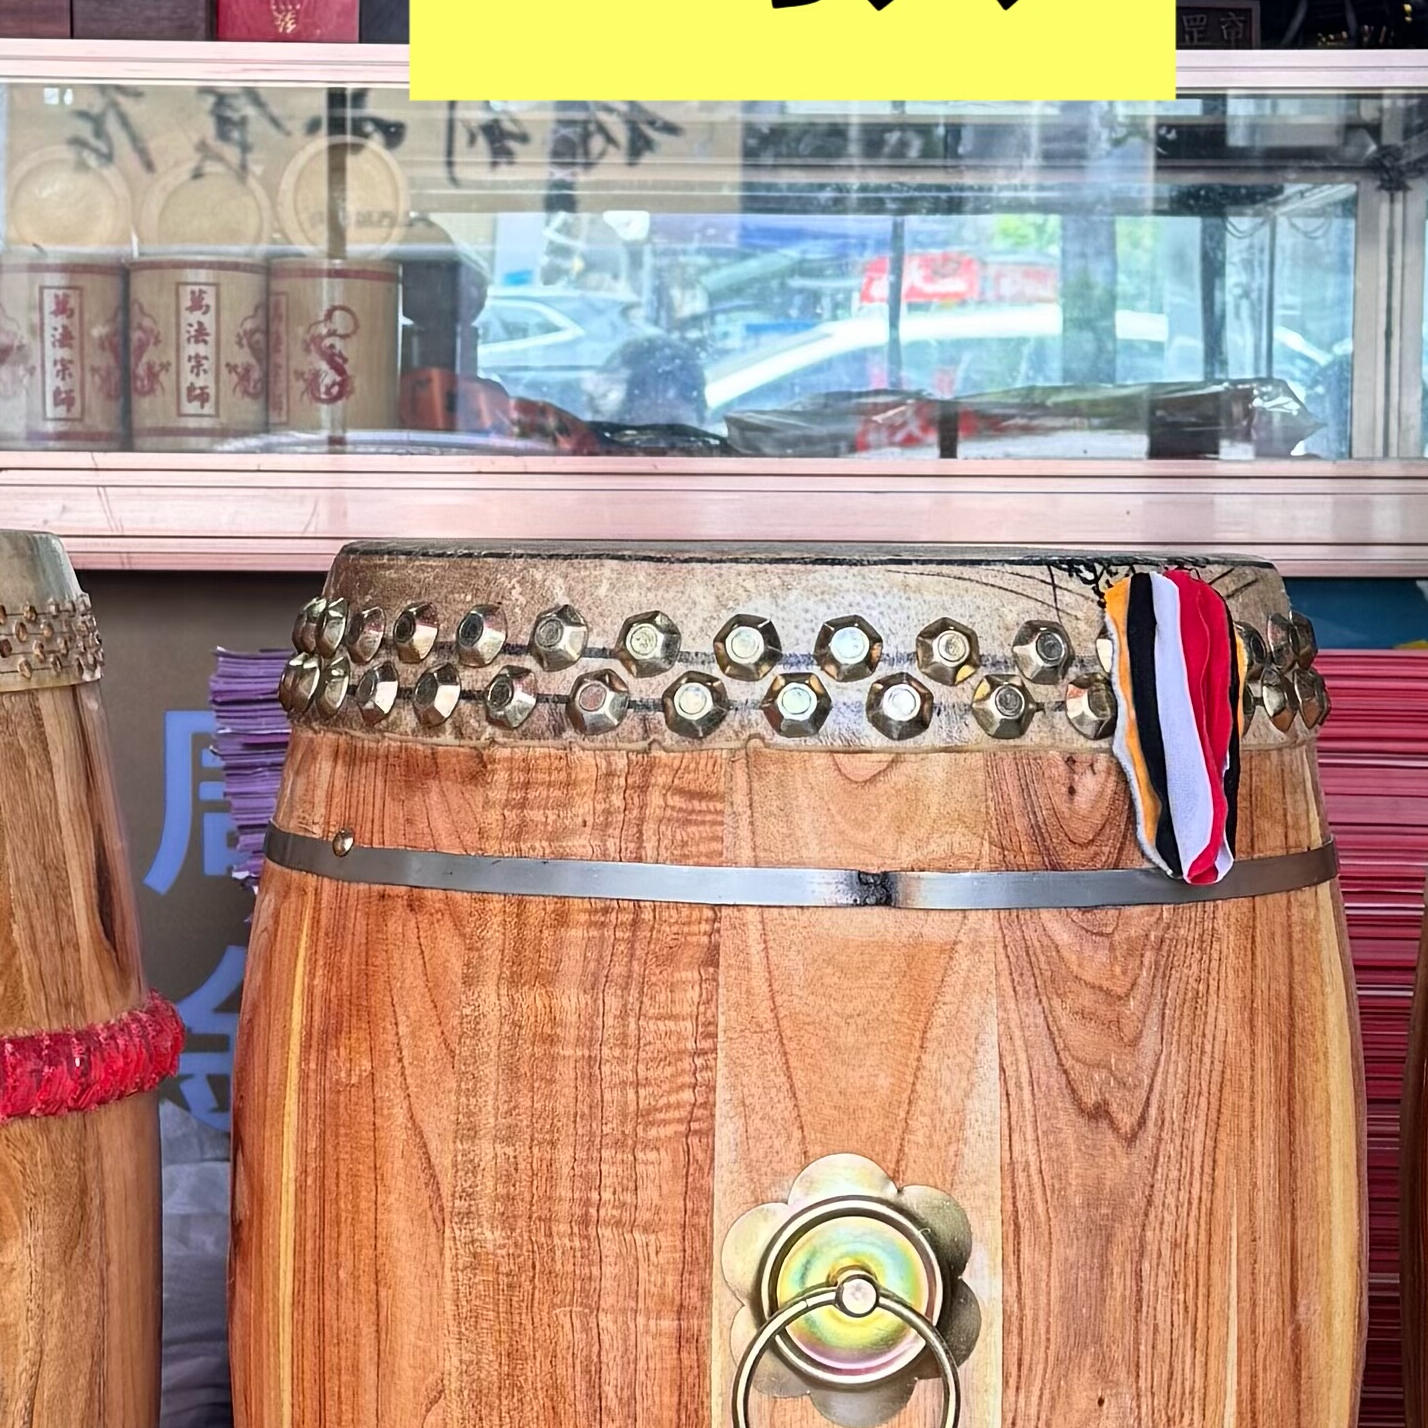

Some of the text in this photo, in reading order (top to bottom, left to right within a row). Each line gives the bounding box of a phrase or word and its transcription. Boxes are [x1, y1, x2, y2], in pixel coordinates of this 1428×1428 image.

[50, 292, 75, 413] 萬法宗師
[185, 289, 212, 410] 萬法宗師
